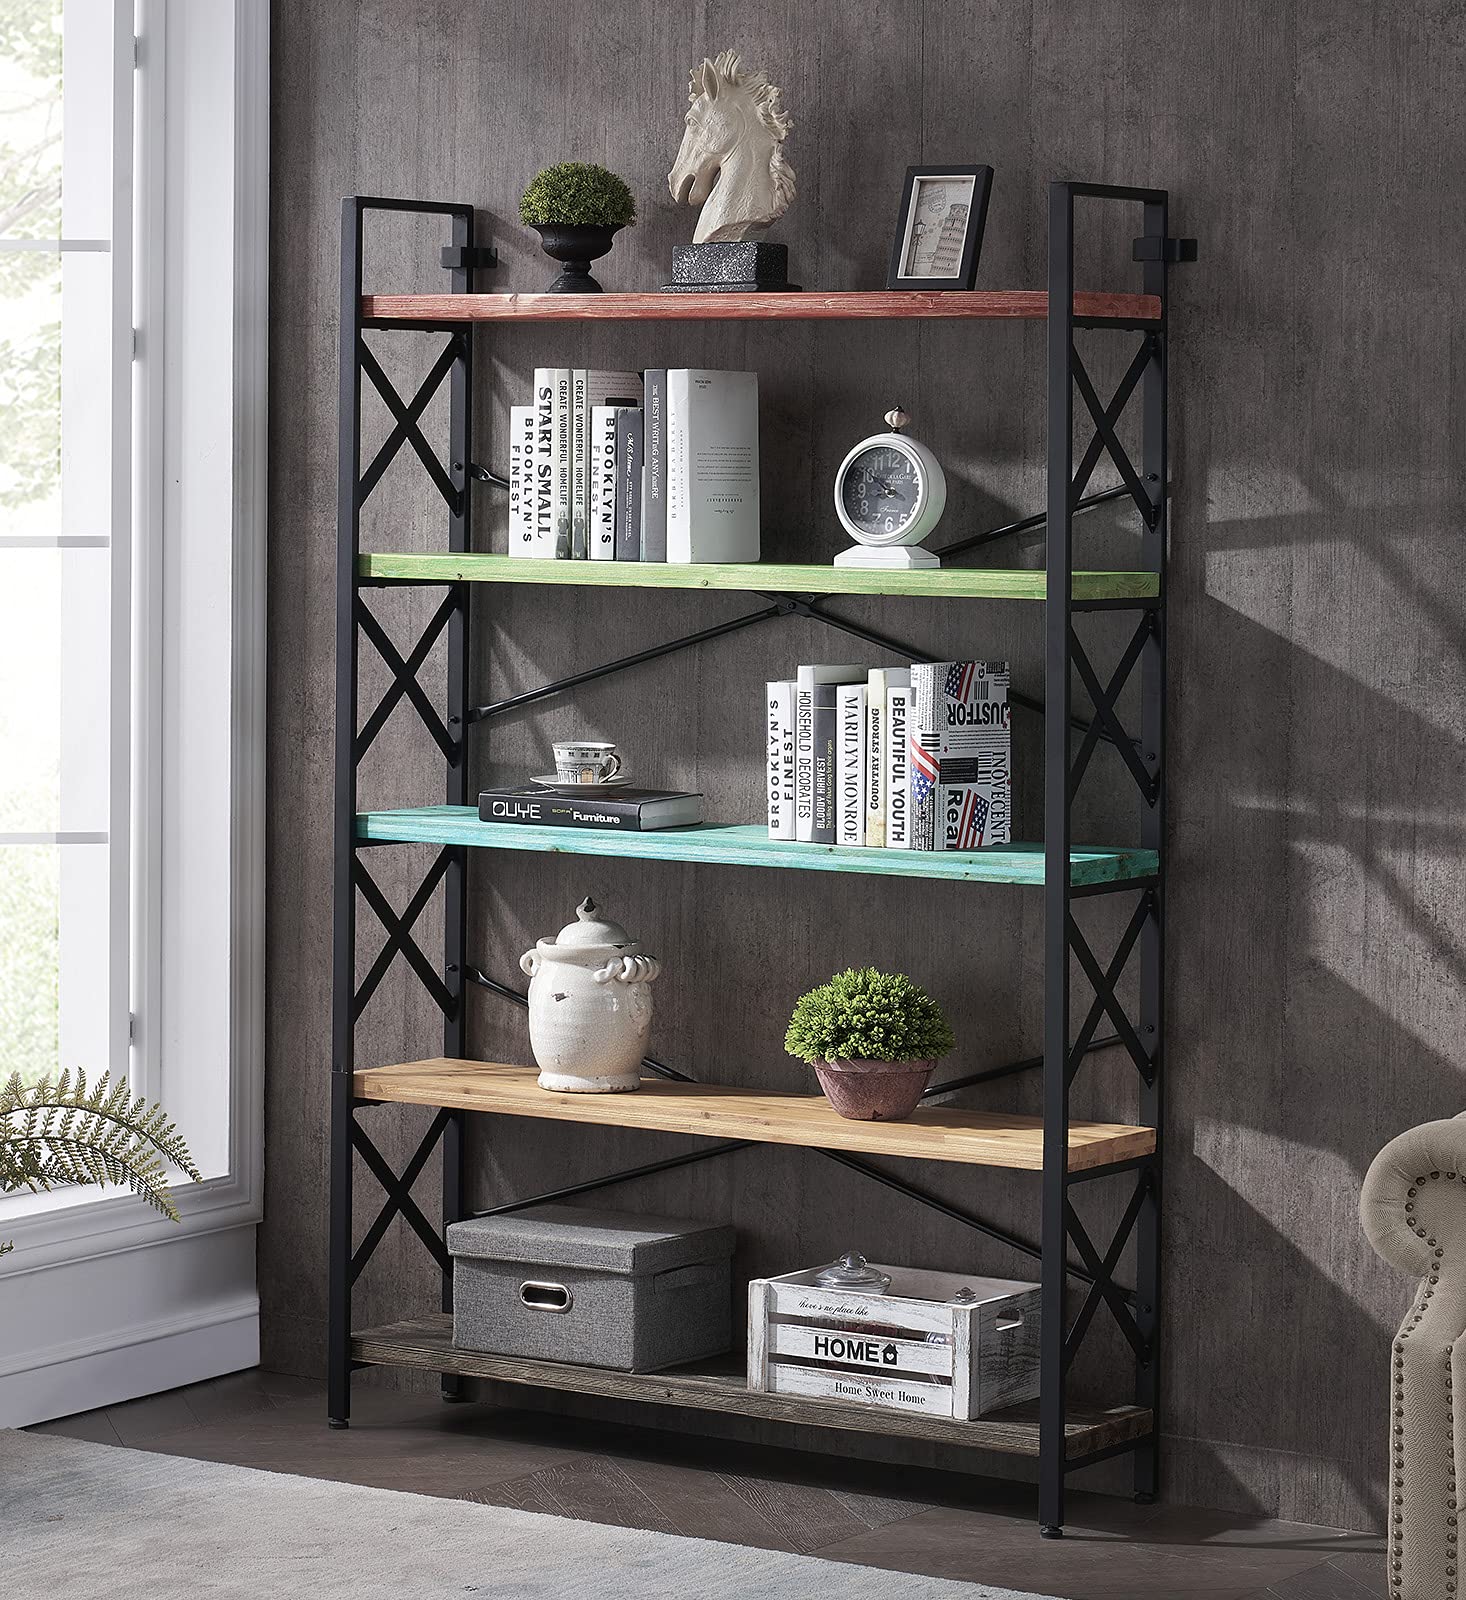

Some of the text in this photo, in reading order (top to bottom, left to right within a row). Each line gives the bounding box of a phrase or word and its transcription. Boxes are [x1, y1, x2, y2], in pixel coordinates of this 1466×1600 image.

[652, 397, 660, 420] BEST
[537, 387, 552, 539] START SMALL
[559, 380, 568, 506] CREATE WONDERFUL HOMELIFE
[575, 379, 584, 506] CREATE WONDERFUL HOMELIFE
[872, 455, 884, 471] 11
[886, 452, 900, 468] 12
[904, 459, 911, 474] 1
[510, 445, 520, 515] FINEST
[523, 418, 534, 542] BROOKLYN'S
[592, 445, 601, 515] FINEST
[601, 417, 615, 544] BROOKLYN'S
[857, 483, 866, 498] 9
[862, 467, 874, 483] 10
[860, 500, 869, 516] 8
[872, 513, 881, 527] 7
[884, 516, 893, 532] 6
[898, 513, 908, 527] 5
[770, 700, 779, 828] BROOKLYN'S
[784, 729, 793, 801] FINEST
[798, 691, 812, 819] HOUSEHOLD DECORATES
[843, 696, 859, 841] MARILYN MONROE
[870, 708, 880, 810] COUNTRY STRONG
[891, 696, 906, 841] BEAUTIFUL YOUTH
[573, 811, 621, 824] Furniture
[816, 757, 826, 829] BLOODY HARVEST
[823, 1304, 834, 1312] no
[832, 1303, 854, 1315] place
[854, 1305, 870, 1316] like
[814, 1335, 880, 1363] HOME
[834, 1382, 926, 1405] Home Sweet Home
